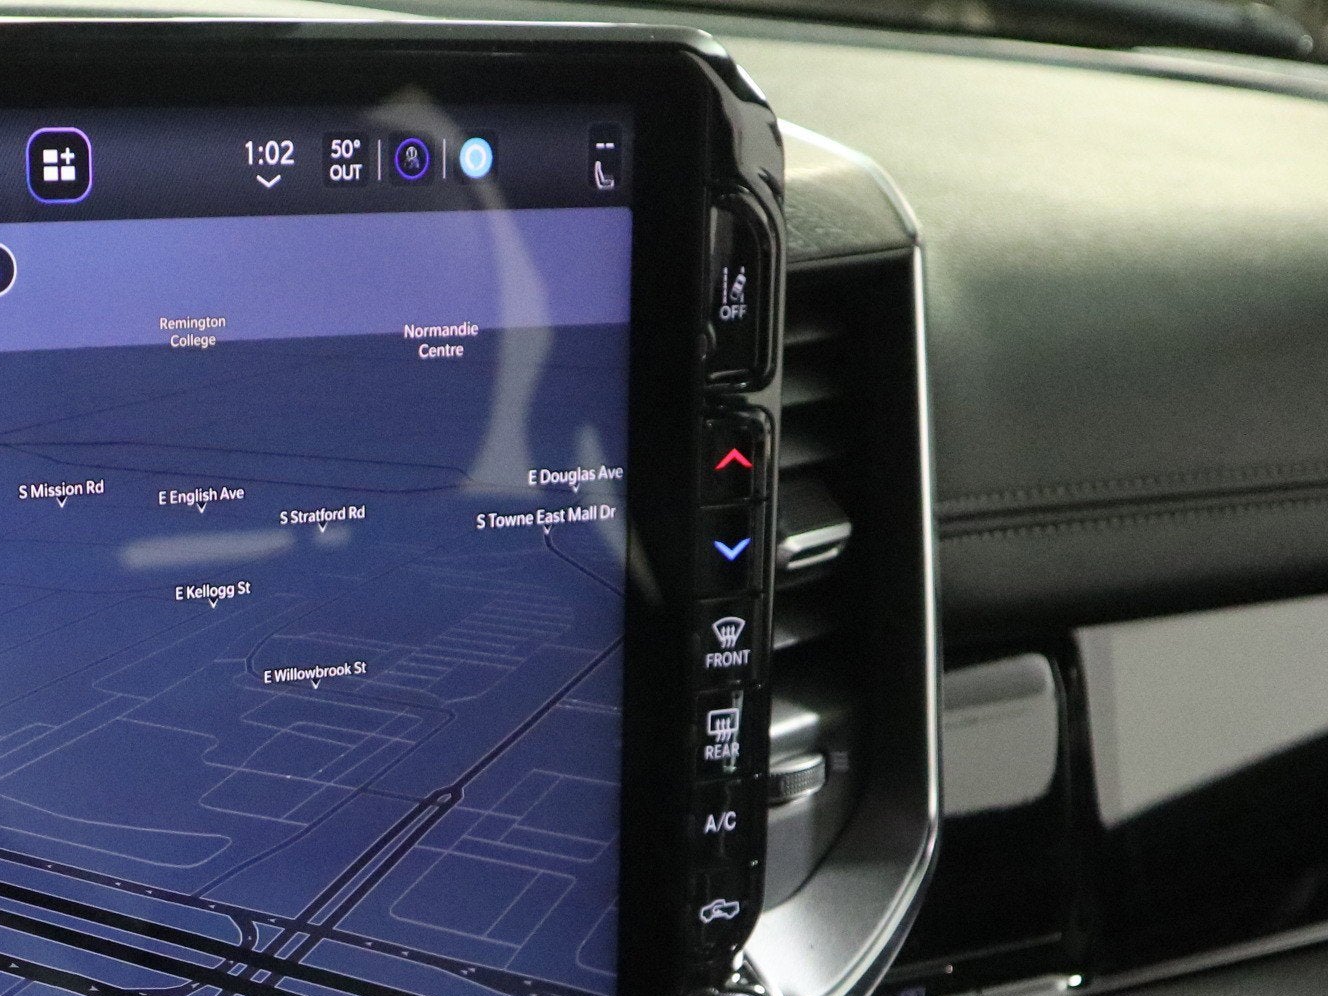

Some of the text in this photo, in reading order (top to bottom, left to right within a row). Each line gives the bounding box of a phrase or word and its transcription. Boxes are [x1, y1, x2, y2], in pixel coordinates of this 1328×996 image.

[245, 140, 295, 165] 1:02
[330, 165, 362, 181] OUT
[719, 304, 747, 320] OFF
[159, 315, 226, 334] Remington
[404, 322, 479, 339] Normandie
[170, 333, 216, 350] College
[418, 342, 464, 359] Centre
[529, 464, 624, 486] E Douglas Ave
[19, 480, 104, 500] S Mission Rd
[158, 487, 245, 505] E English Ave
[280, 505, 366, 525] S Stratford Rd
[476, 504, 616, 529] S Towne East Mall Dr
[175, 581, 251, 602] E Kellogg St
[706, 649, 751, 669] FRONT
[264, 661, 367, 684] E Willowbrook St
[705, 743, 740, 761] REAR
[704, 811, 737, 835] A/C
